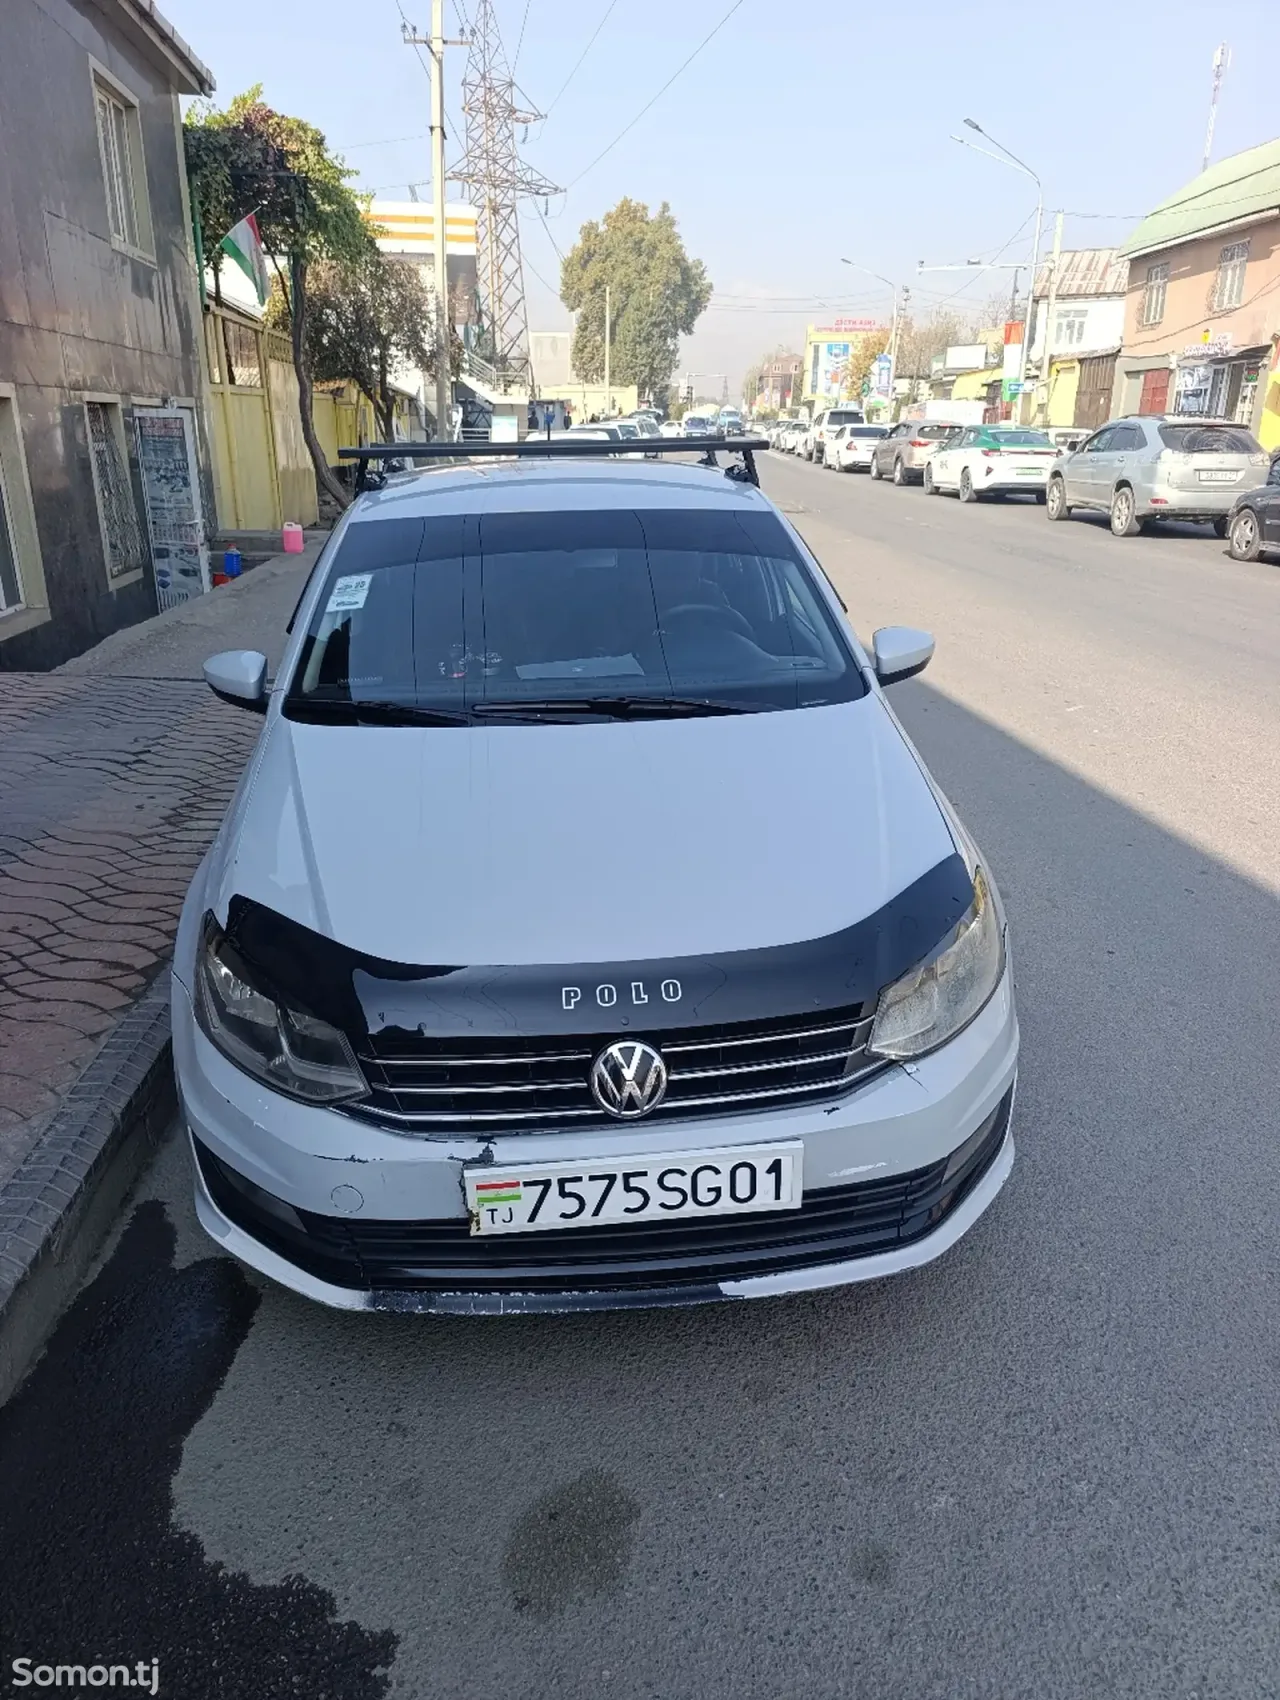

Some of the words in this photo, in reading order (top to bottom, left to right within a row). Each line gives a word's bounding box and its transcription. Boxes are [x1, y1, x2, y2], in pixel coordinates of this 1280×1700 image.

[562, 979, 682, 1010] POLO
[522, 1158, 782, 1224] 7575SG01
[486, 1207, 514, 1225] TJ
